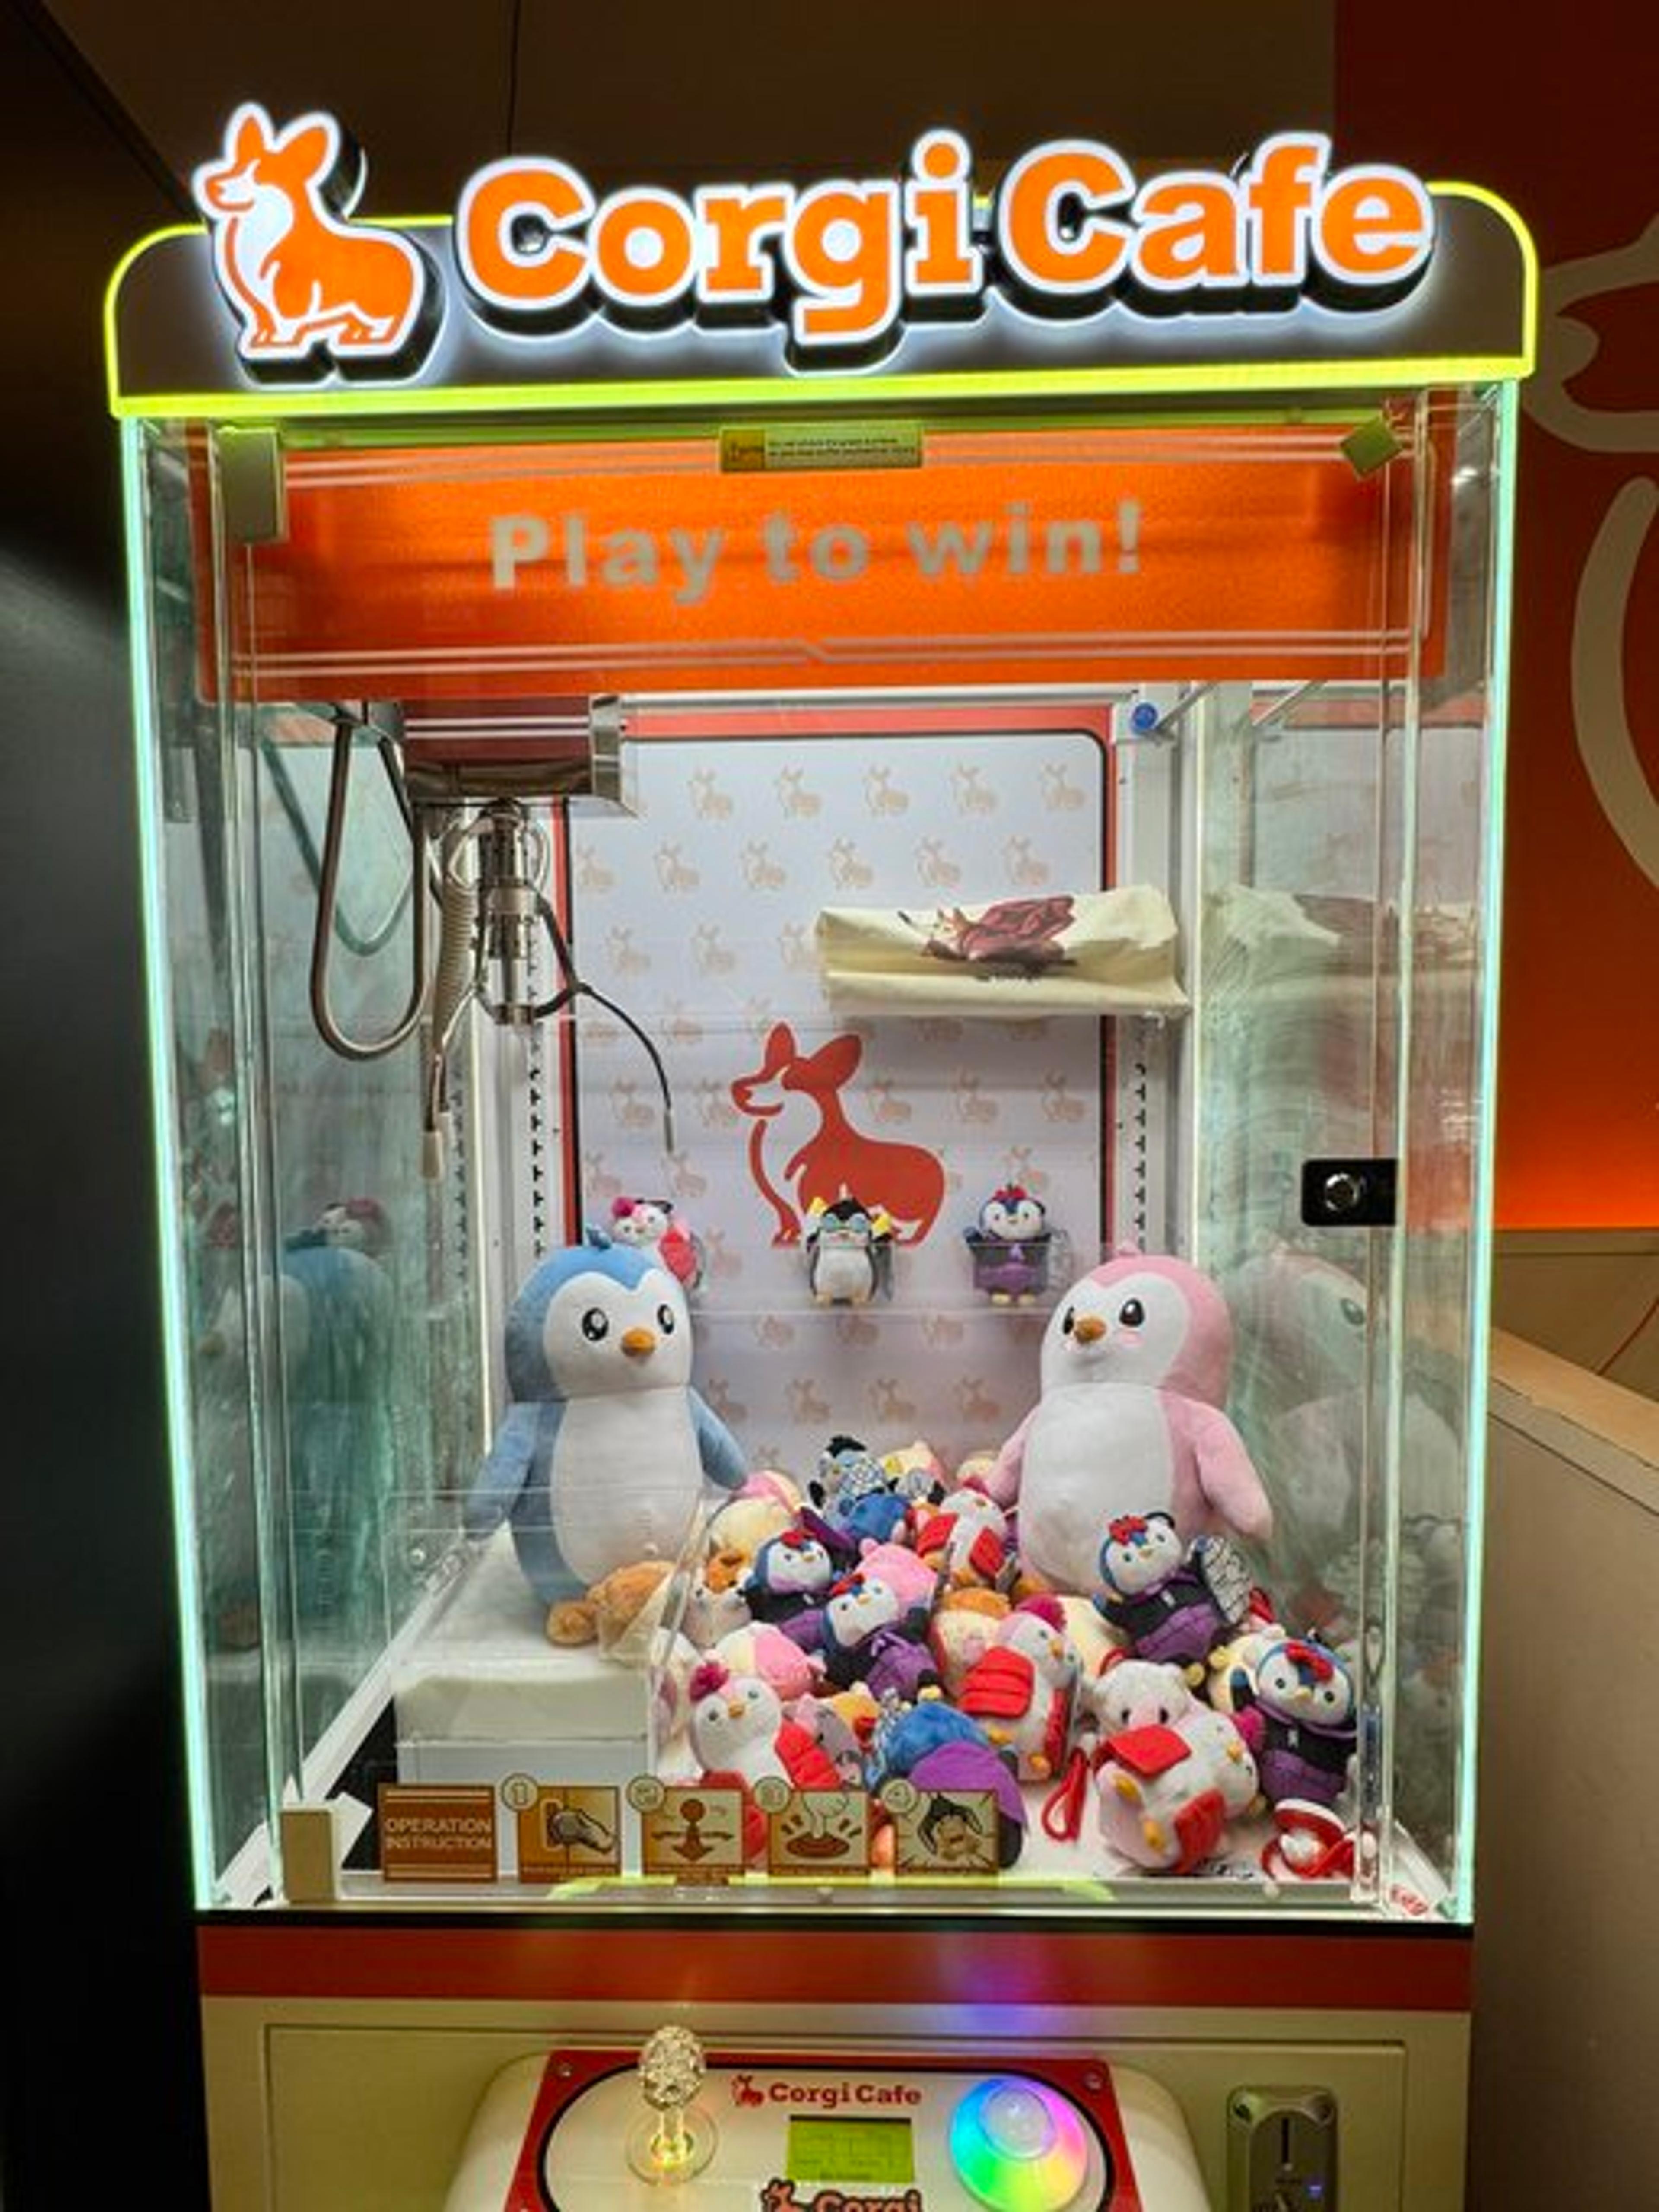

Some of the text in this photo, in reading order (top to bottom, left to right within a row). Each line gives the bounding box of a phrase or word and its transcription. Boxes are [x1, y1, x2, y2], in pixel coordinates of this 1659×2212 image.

[460, 131, 1433, 342] Corgi Cafe
[492, 499, 1140, 604] Play to win!
[386, 1816, 492, 1833] OPERATION
[386, 1835, 492, 1851] INSTRUCTION
[769, 2082, 922, 2109] Corgi Cafe
